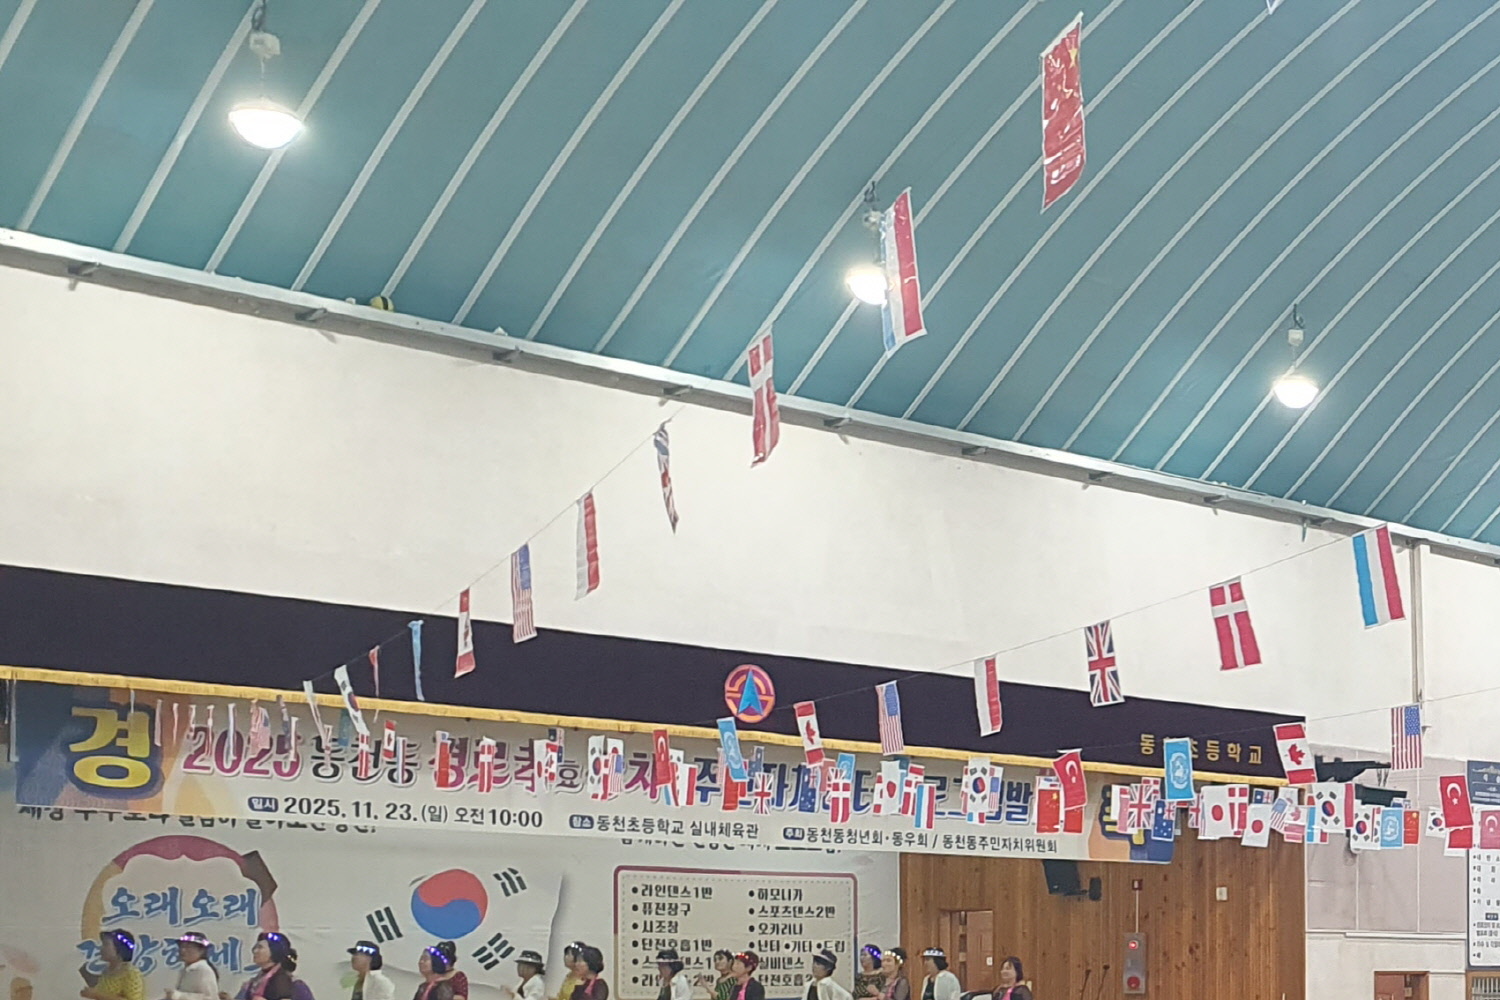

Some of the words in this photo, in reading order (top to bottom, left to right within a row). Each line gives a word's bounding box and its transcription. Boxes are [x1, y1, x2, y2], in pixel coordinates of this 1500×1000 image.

[69, 706, 152, 789] 경
[183, 726, 301, 779] 2025
[251, 798, 277, 812] 일시
[284, 797, 346, 818] 2025.
[352, 801, 379, 820] 11.
[596, 815, 685, 835] 동천초등학교
[690, 820, 759, 840] 실내체육관
[942, 834, 1058, 854] 동천동주민자치위원회
[641, 883, 713, 900] 라인댄스1반
[757, 888, 803, 902] 하모니카
[641, 902, 692, 917] 퓨전장구
[757, 905, 836, 919] 스포츠댄스2반
[641, 919, 679, 934] 시조창
[757, 922, 803, 936] 오카리나
[641, 937, 713, 952] 단전호흡1반
